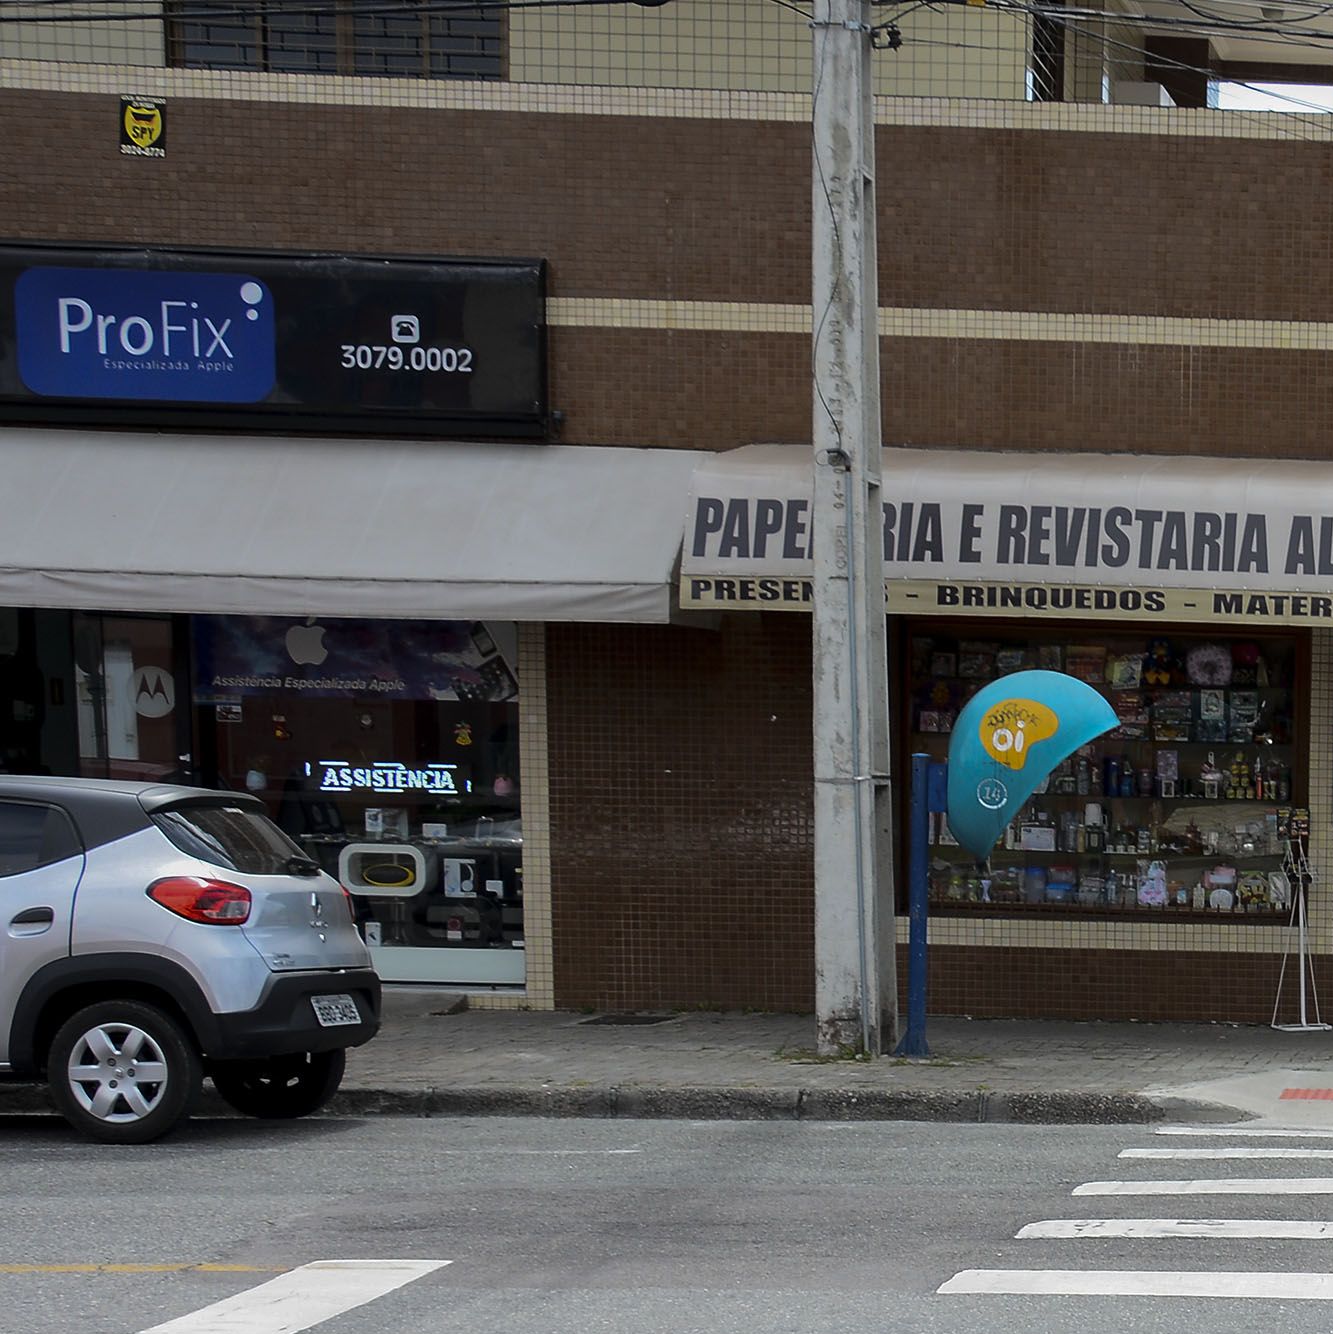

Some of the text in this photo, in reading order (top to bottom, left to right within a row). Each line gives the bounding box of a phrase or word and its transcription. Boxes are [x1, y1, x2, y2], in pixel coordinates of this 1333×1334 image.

[132, 125, 155, 141] SPY
[57, 297, 234, 359] ProFix
[103, 358, 190, 372] Especializada
[341, 345, 473, 372] 3079.0002
[692, 497, 944, 563] PAPERIA
[959, 503, 985, 563] E
[996, 504, 1269, 574] REVISTARIA
[937, 585, 1166, 612] BRINQUEDOS
[212, 675, 406, 692] Assistência Especializada Apple
[992, 720, 1026, 752] oi
